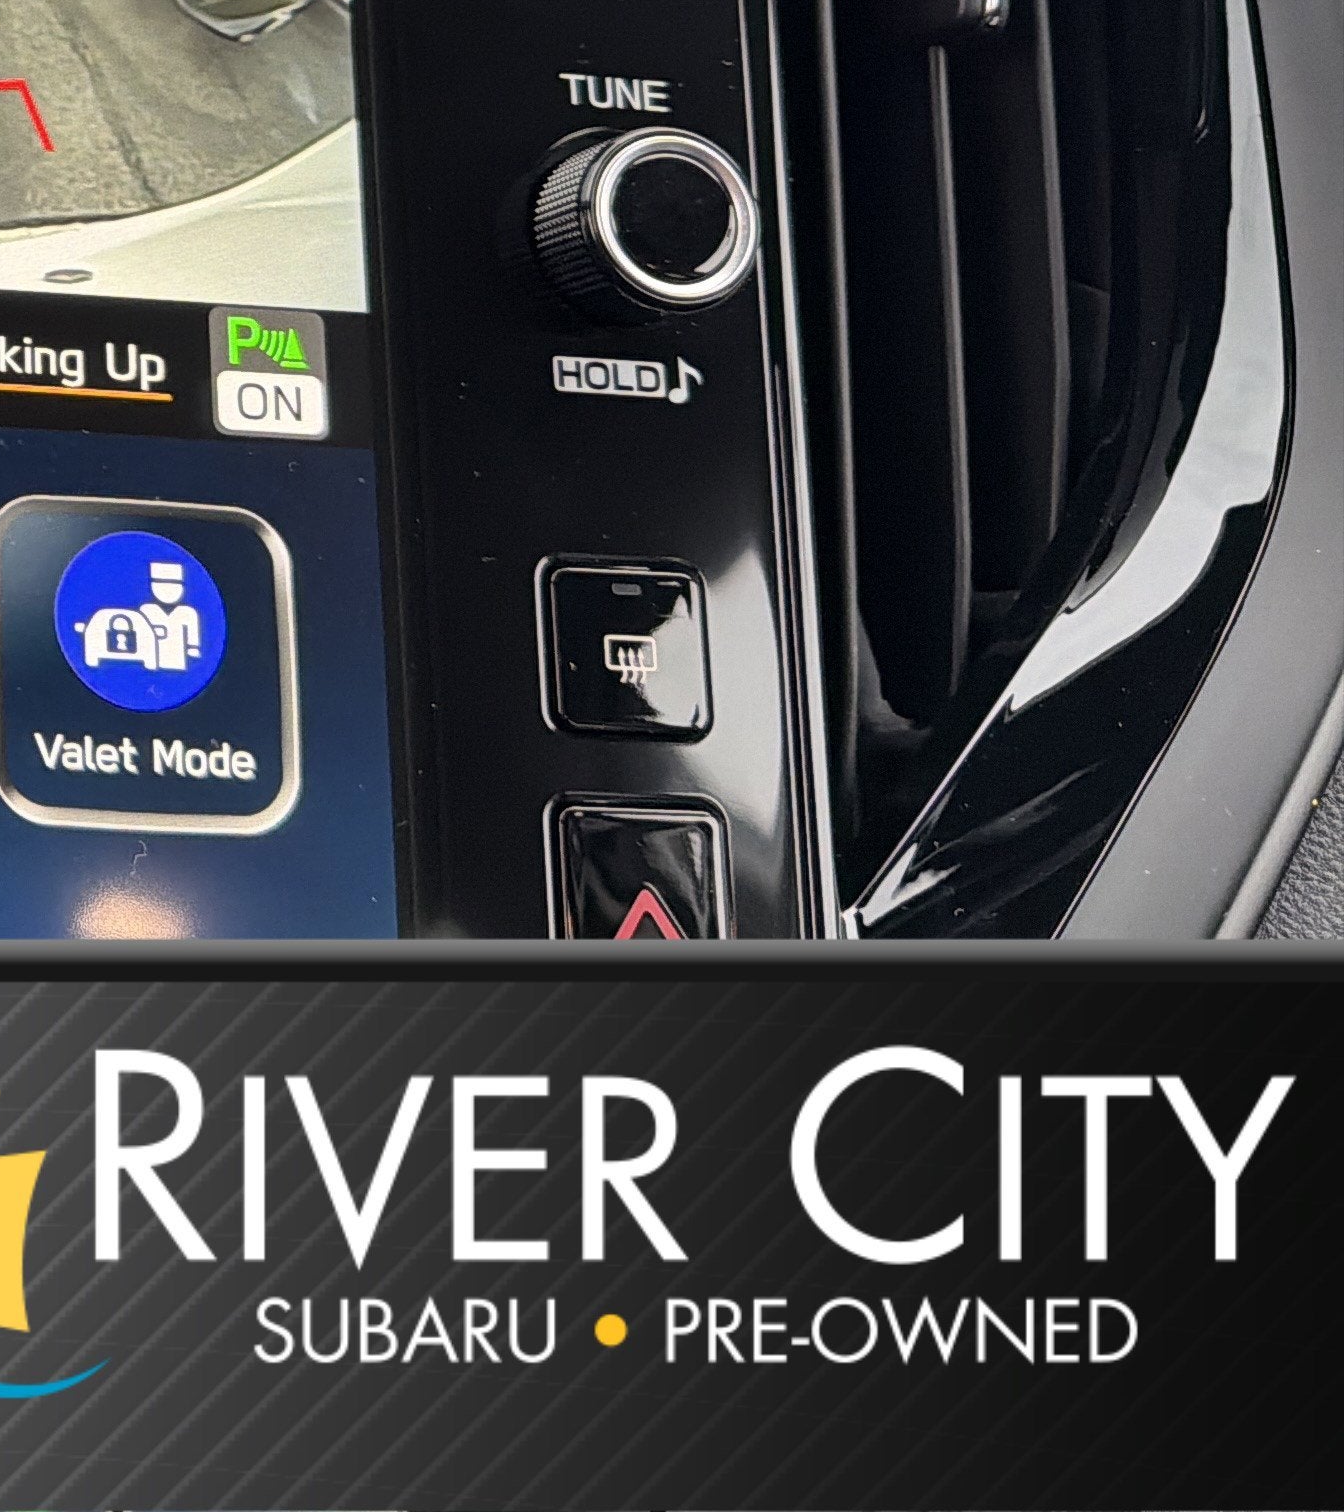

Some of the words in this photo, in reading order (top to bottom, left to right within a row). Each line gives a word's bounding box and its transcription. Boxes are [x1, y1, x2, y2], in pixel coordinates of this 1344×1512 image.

[559, 71, 671, 115] TUNE
[105, 344, 167, 388] Up
[557, 357, 663, 396] HOLD
[235, 383, 305, 426] ON
[35, 733, 139, 775] Valet
[152, 738, 257, 781] Mode
